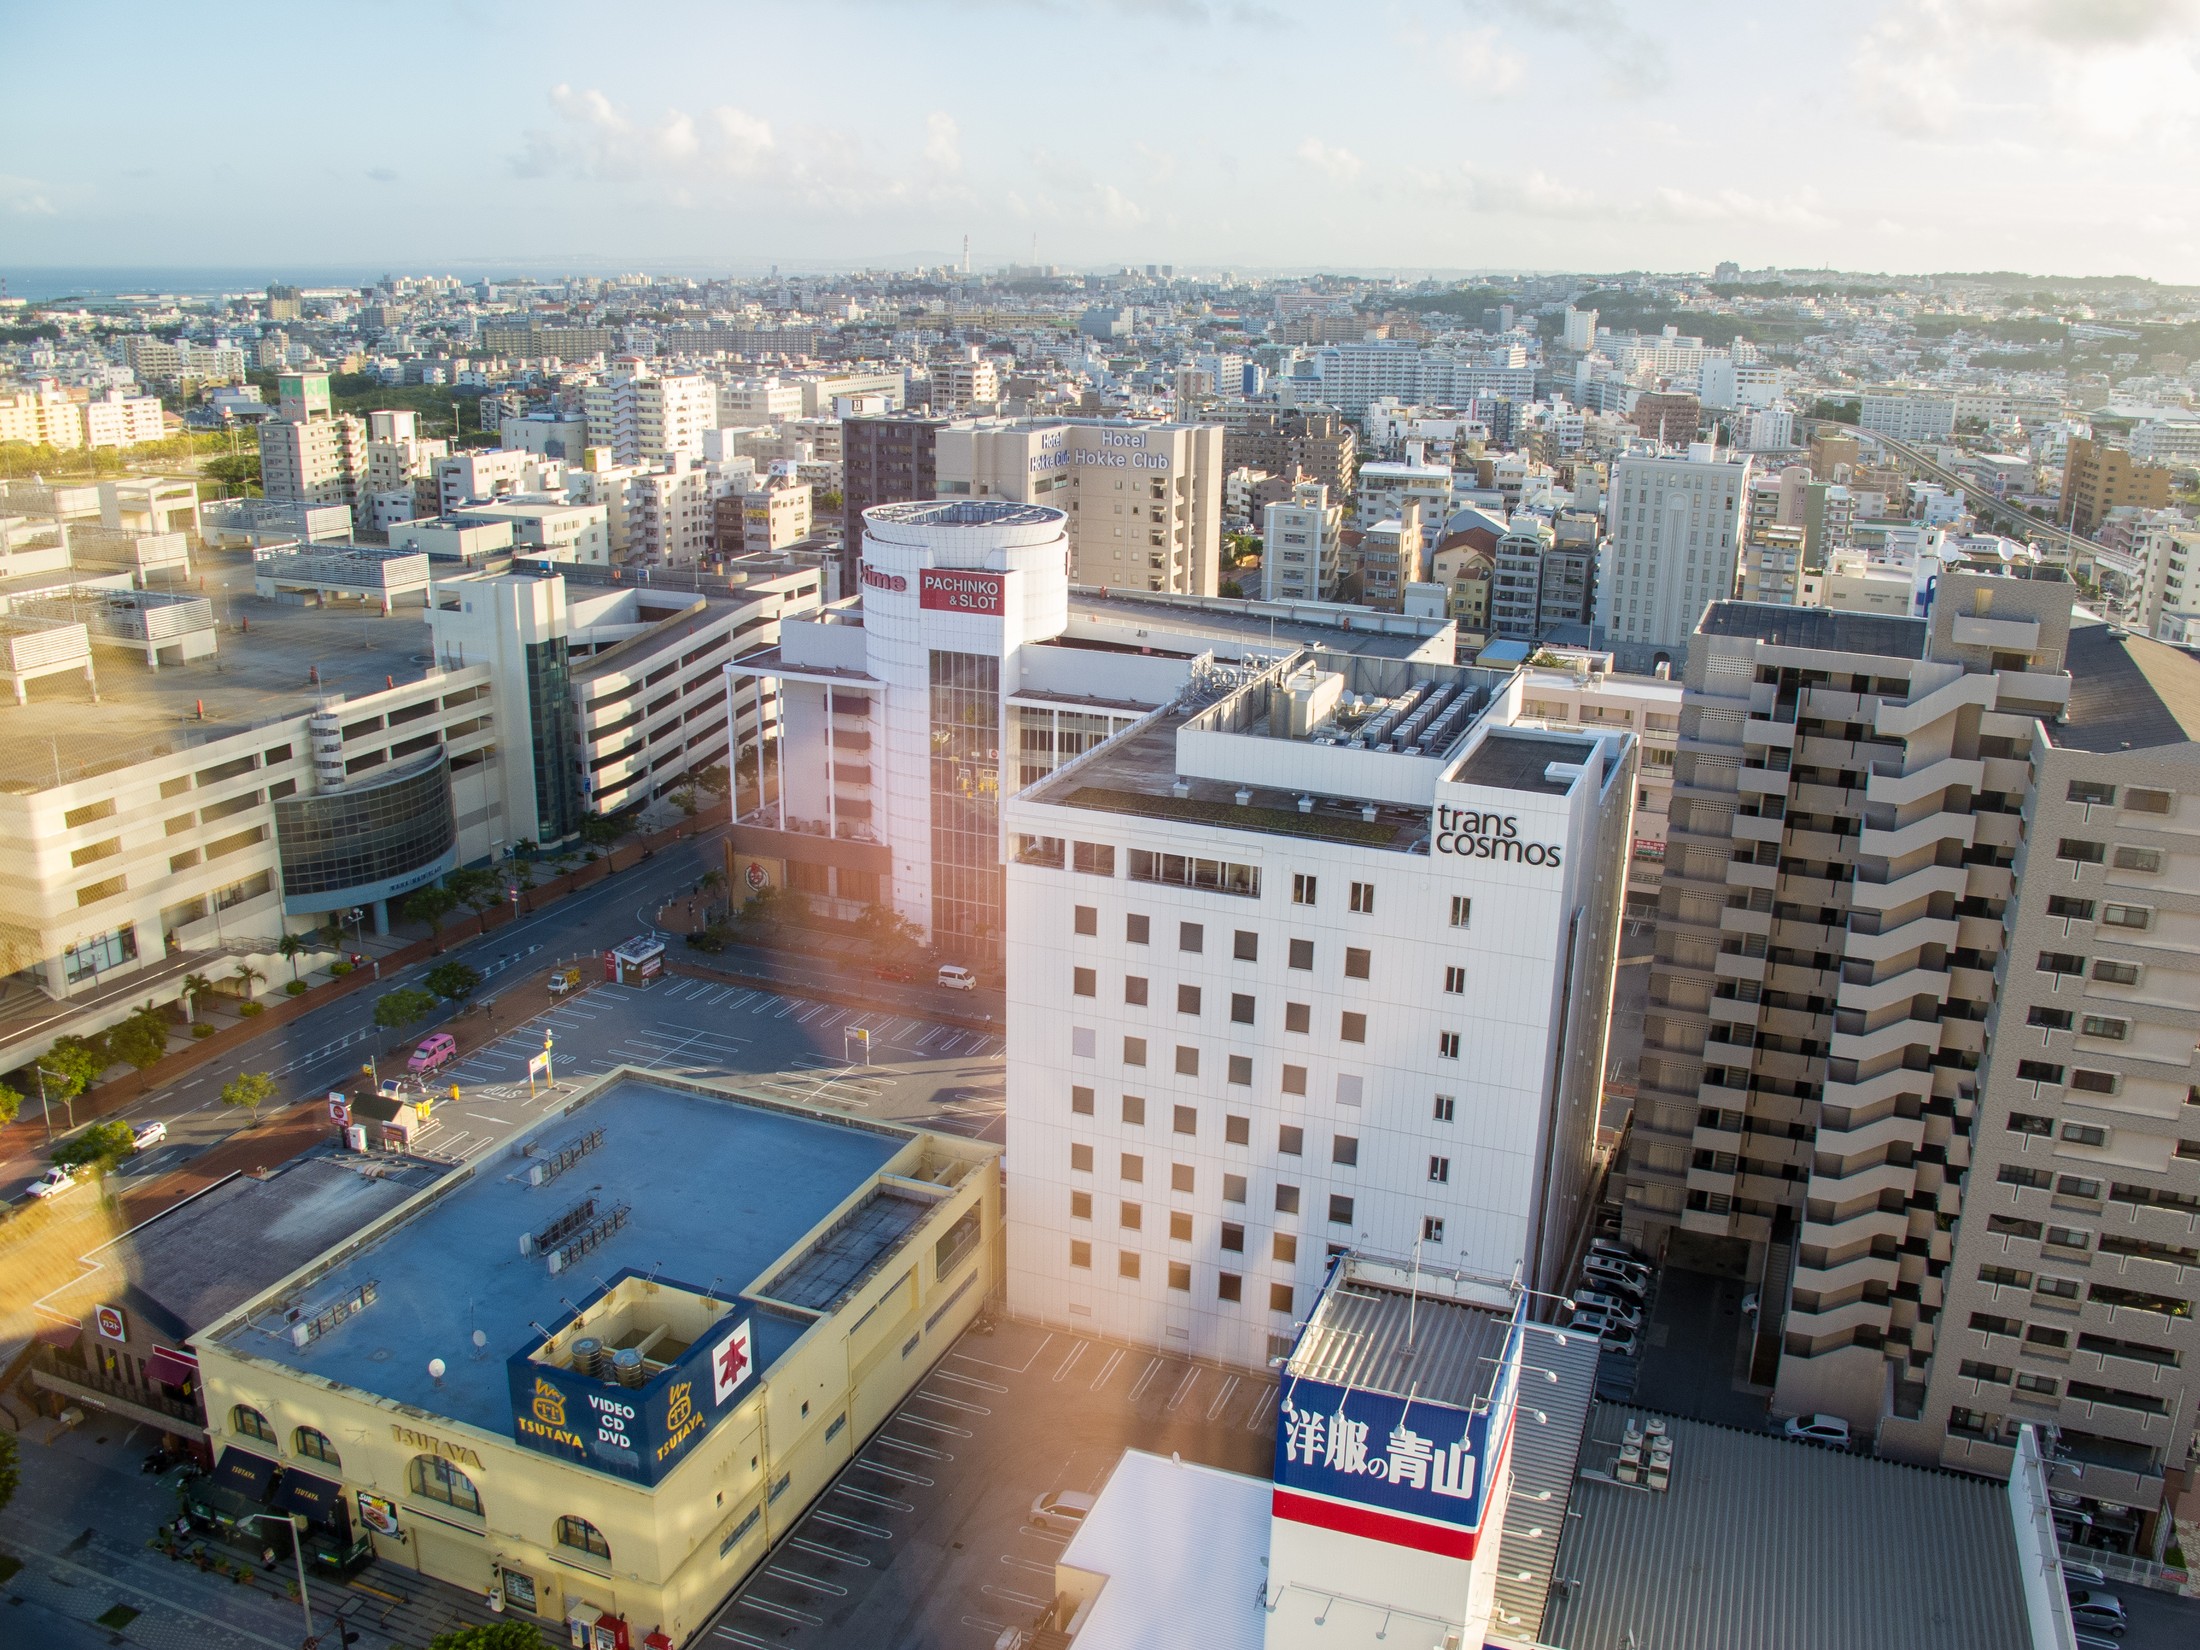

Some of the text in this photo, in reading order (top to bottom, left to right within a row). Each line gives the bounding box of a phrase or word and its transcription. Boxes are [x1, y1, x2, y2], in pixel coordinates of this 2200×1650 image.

[1042, 432, 1061, 449] Hotel
[1101, 430, 1146, 448] Hotel
[1030, 449, 1071, 472] Hokke Club
[1075, 448, 1170, 470] Hokke Club
[925, 576, 999, 596] PACHINKO
[949, 594, 998, 610] & SLOT
[1437, 803, 1518, 839] trans
[1436, 831, 1562, 869] cosmos
[482, 1085, 523, 1099] STOP
[102, 1319, 119, 1331] ガスト
[718, 1335, 748, 1389] 本
[588, 1394, 636, 1420] VIDEO
[518, 1417, 584, 1449] TSUTAYA
[601, 1414, 626, 1431] CD
[390, 1423, 482, 1469] TSUTAYA
[599, 1428, 632, 1449] DVD
[656, 1411, 704, 1462] TSUTAYA
[1284, 1408, 1476, 1500] 洋服の青山
[231, 1465, 255, 1480] TSUTAYA
[294, 1487, 319, 1501] TSUTAYA
